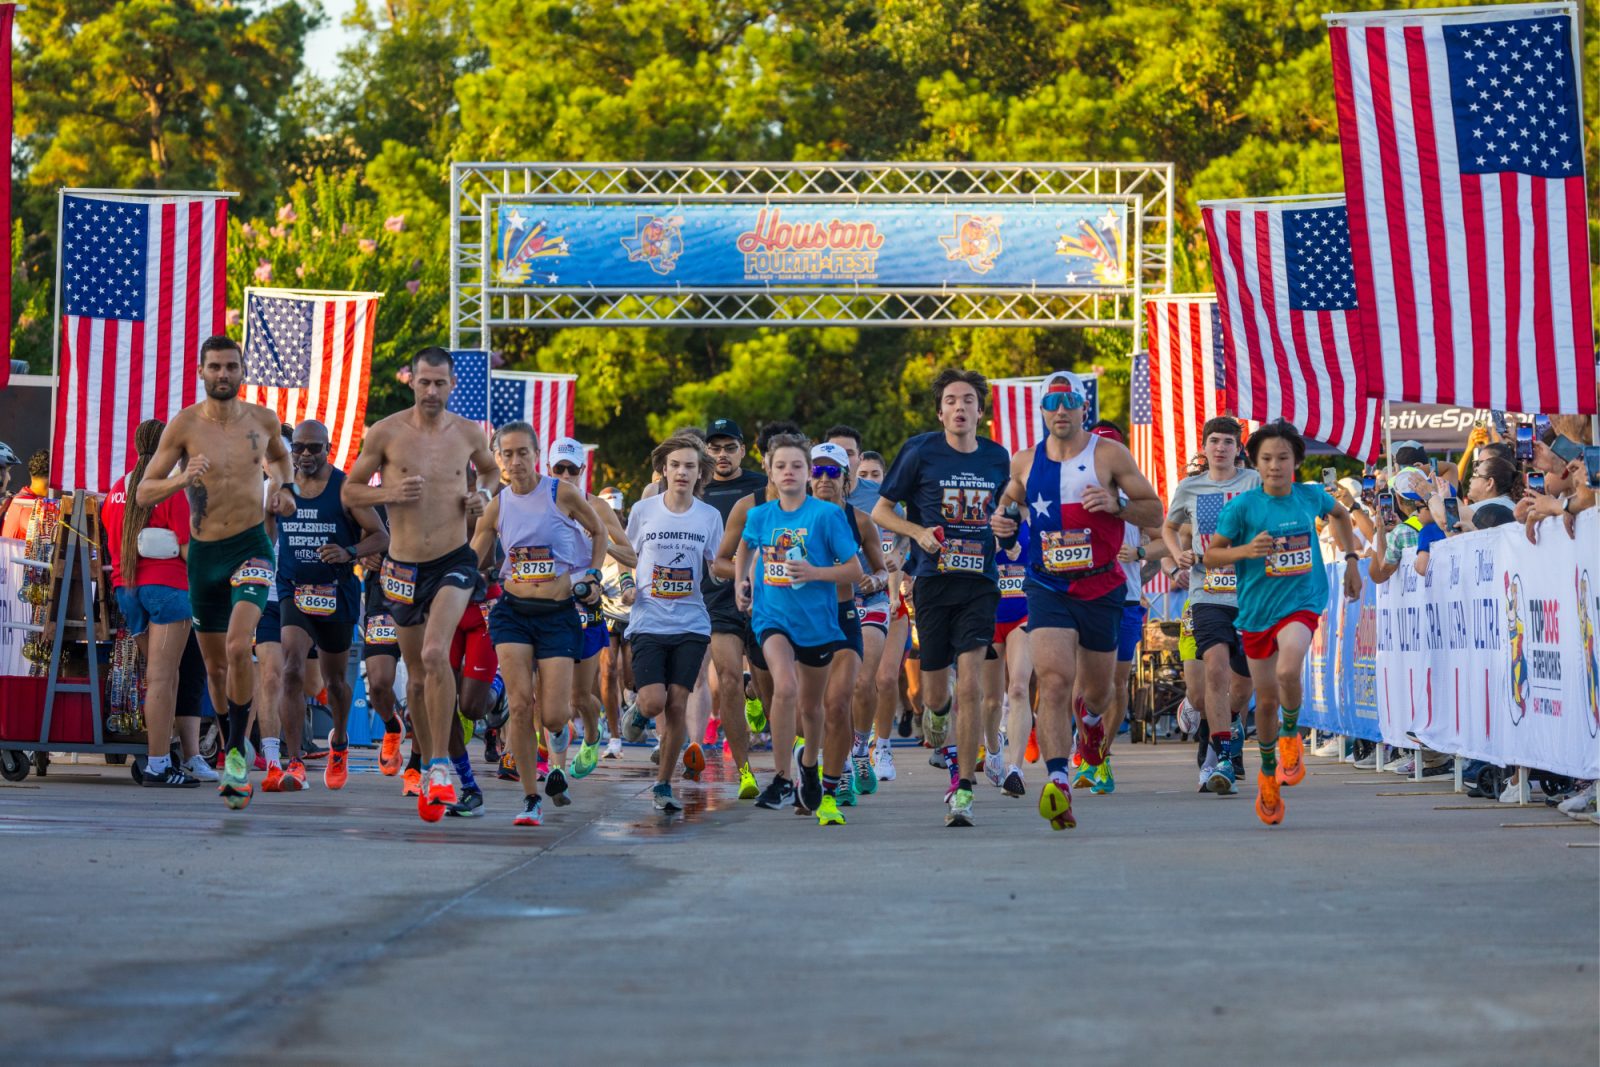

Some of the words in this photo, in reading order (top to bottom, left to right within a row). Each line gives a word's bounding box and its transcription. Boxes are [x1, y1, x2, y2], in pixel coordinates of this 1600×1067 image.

[737, 208, 884, 252] Houston
[744, 251, 822, 273] FOURTH
[830, 251, 879, 273] FEST
[959, 480, 995, 489] ANTONIO
[111, 492, 126, 504] VOL
[942, 488, 992, 525] 5K
[297, 509, 318, 519] RUN
[282, 522, 336, 534] REPLENISH
[289, 536, 329, 547] REPEAT
[646, 532, 657, 541] DO
[658, 532, 706, 543] SOMETHING
[1055, 547, 1091, 562] 8997
[1279, 550, 1312, 566] 9133
[523, 562, 554, 574] 8787
[951, 555, 983, 569] 8515
[242, 569, 274, 581] 8932
[770, 564, 787, 577] 88
[662, 582, 693, 592] 9154
[999, 579, 1022, 589] 890
[1214, 576, 1236, 586] 905
[387, 578, 413, 598] 8913
[305, 597, 336, 608] 8696
[1473, 599, 1500, 650] ULTRA
[376, 628, 397, 637] 854
